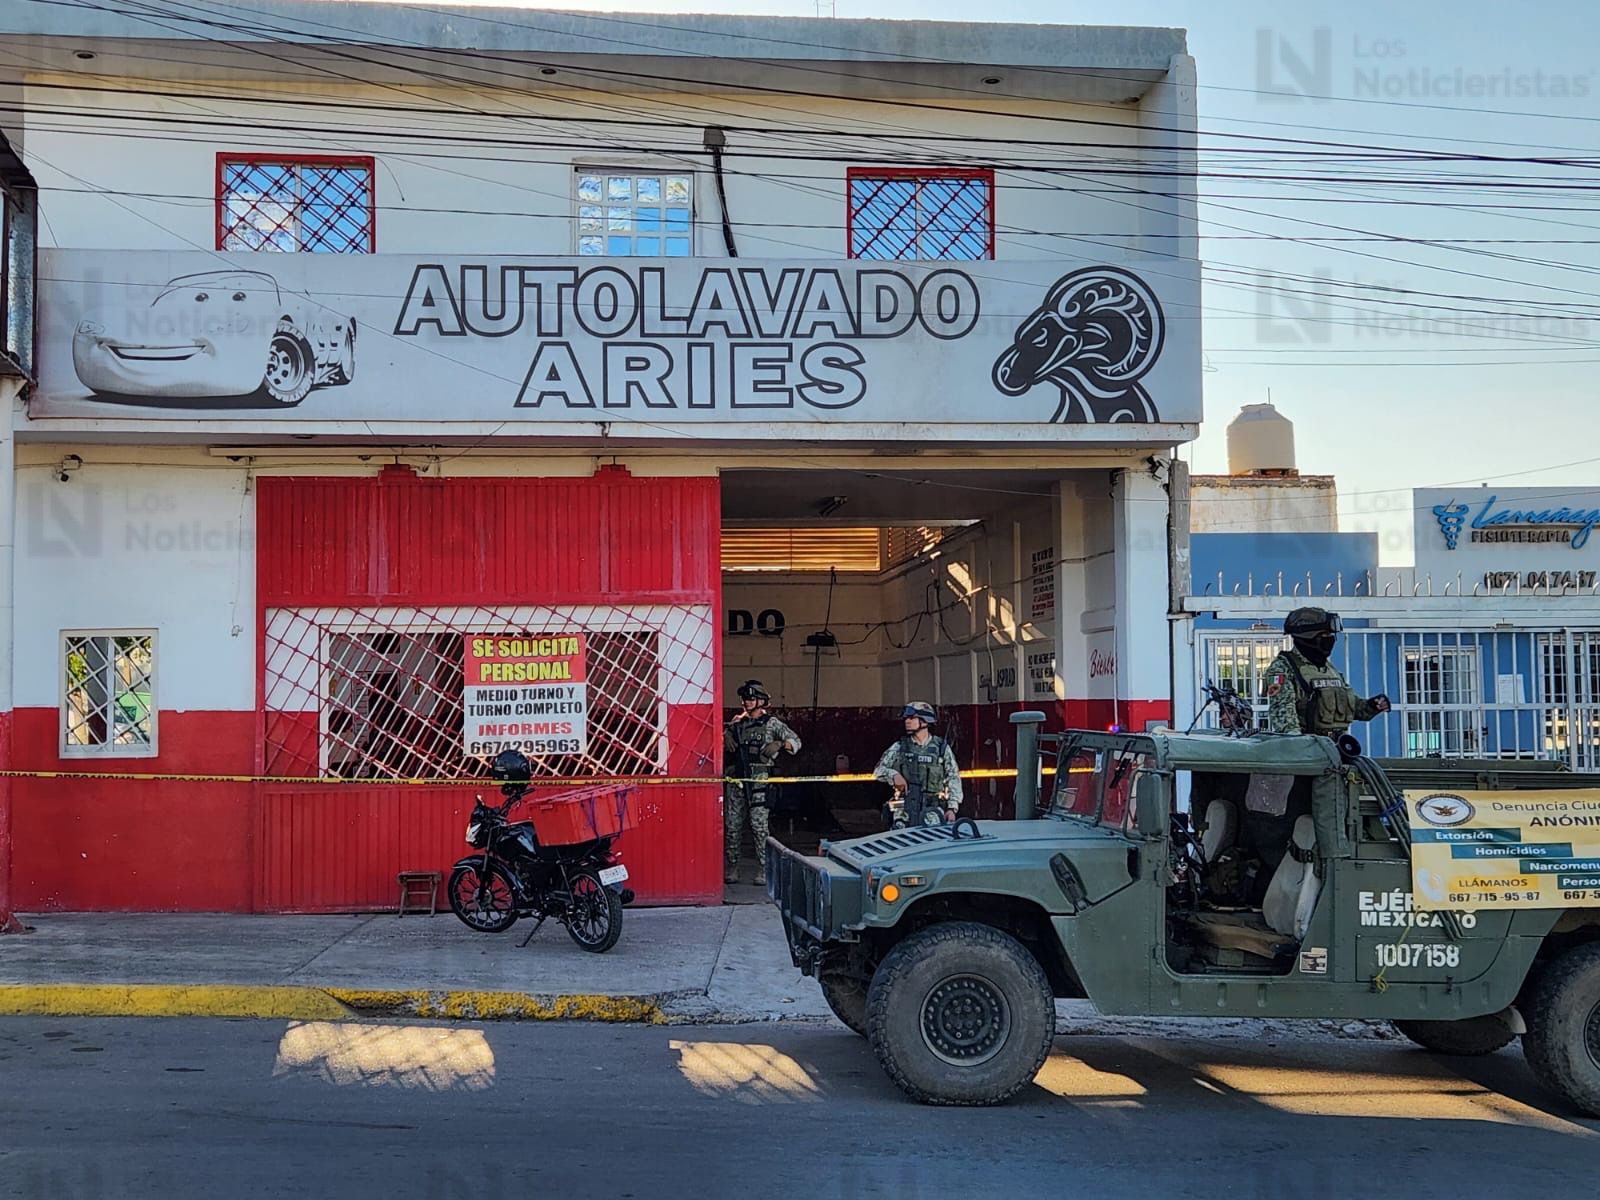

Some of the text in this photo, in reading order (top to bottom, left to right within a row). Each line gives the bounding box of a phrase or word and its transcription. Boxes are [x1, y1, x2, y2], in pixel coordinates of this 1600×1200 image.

[393, 264, 981, 340] AUTOLAVADO
[513, 341, 867, 409] ARIES
[1471, 530, 1571, 543] FISIOTERAPIA
[472, 637, 579, 658] SE SOLICITA
[480, 661, 572, 682] PERSONAL
[476, 687, 575, 702] MEDIO TURNO Y
[469, 701, 583, 717] TURNO COMPLETO
[478, 721, 573, 737] INFORMES
[470, 738, 580, 755] 6674295963
[1492, 801, 1568, 812] Denuncia
[1435, 831, 1494, 841] Extorsión
[1475, 846, 1547, 856] Homicidios
[1458, 877, 1528, 888] LLÁMANOS
[1562, 877, 1600, 887] Perso
[1361, 911, 1477, 929] MEXICAO
[1375, 943, 1460, 968] 1007158
